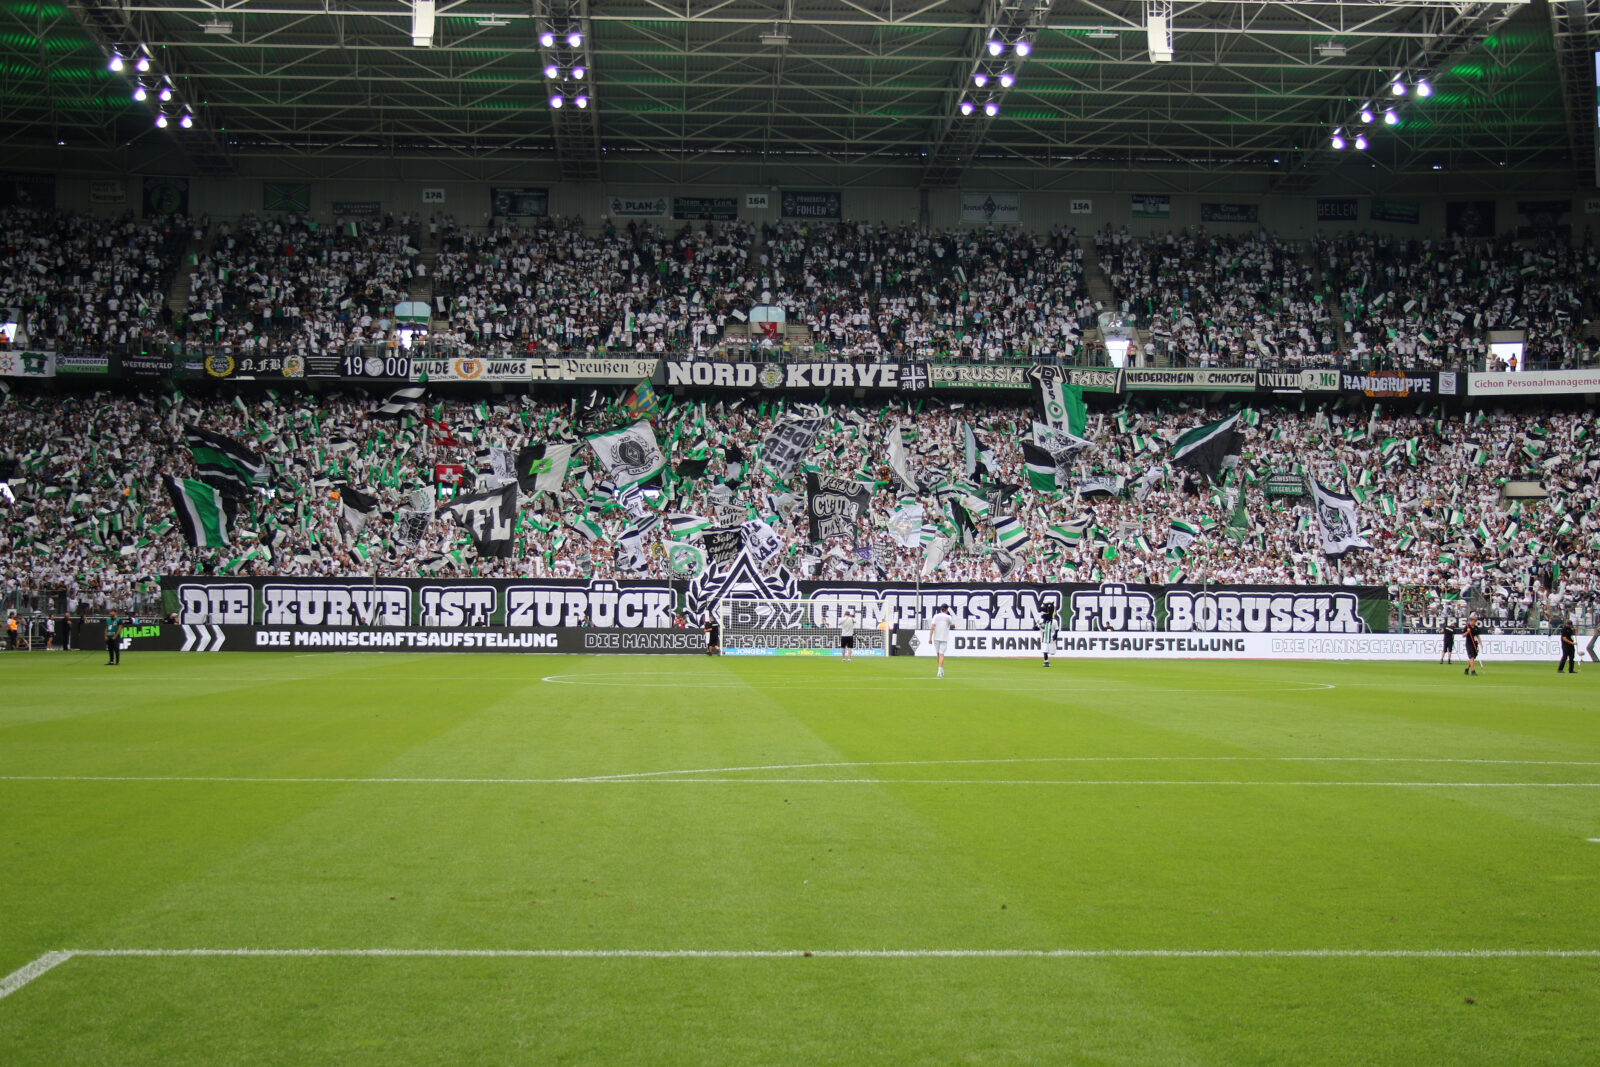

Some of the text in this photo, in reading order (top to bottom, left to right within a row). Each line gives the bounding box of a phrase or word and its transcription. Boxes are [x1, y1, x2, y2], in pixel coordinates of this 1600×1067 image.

[424, 191, 442, 200] 17A
[624, 201, 652, 211] PLAN
[1072, 202, 1090, 210] 15A
[1317, 203, 1358, 217] BEELEN
[121, 359, 173, 370] WESTERWALD
[413, 361, 526, 375] WILDE JUNGS
[666, 361, 899, 388] NORD KURVE
[931, 365, 1116, 387] BORUSSIA FANS
[1126, 371, 1255, 384] NIEDERRHEIN CHAOTEN
[1258, 372, 1337, 387] UNITED MG
[1342, 374, 1431, 393] RANDGRUPPE
[1474, 379, 1504, 389] Cichon
[182, 583, 1361, 633] DIE KURVE IST ZURÜCK GEMEINSAM FÜR BORUSSIA
[256, 631, 559, 648] DIE MANNSCHAFTSAUFSTELLUNG
[584, 632, 883, 650] DIE MANNSCHFTSAUFSTELLNG
[954, 635, 1246, 653] DIE MANNCHAFTSAUFSTELLUNG
[1271, 638, 1305, 653] DIE
